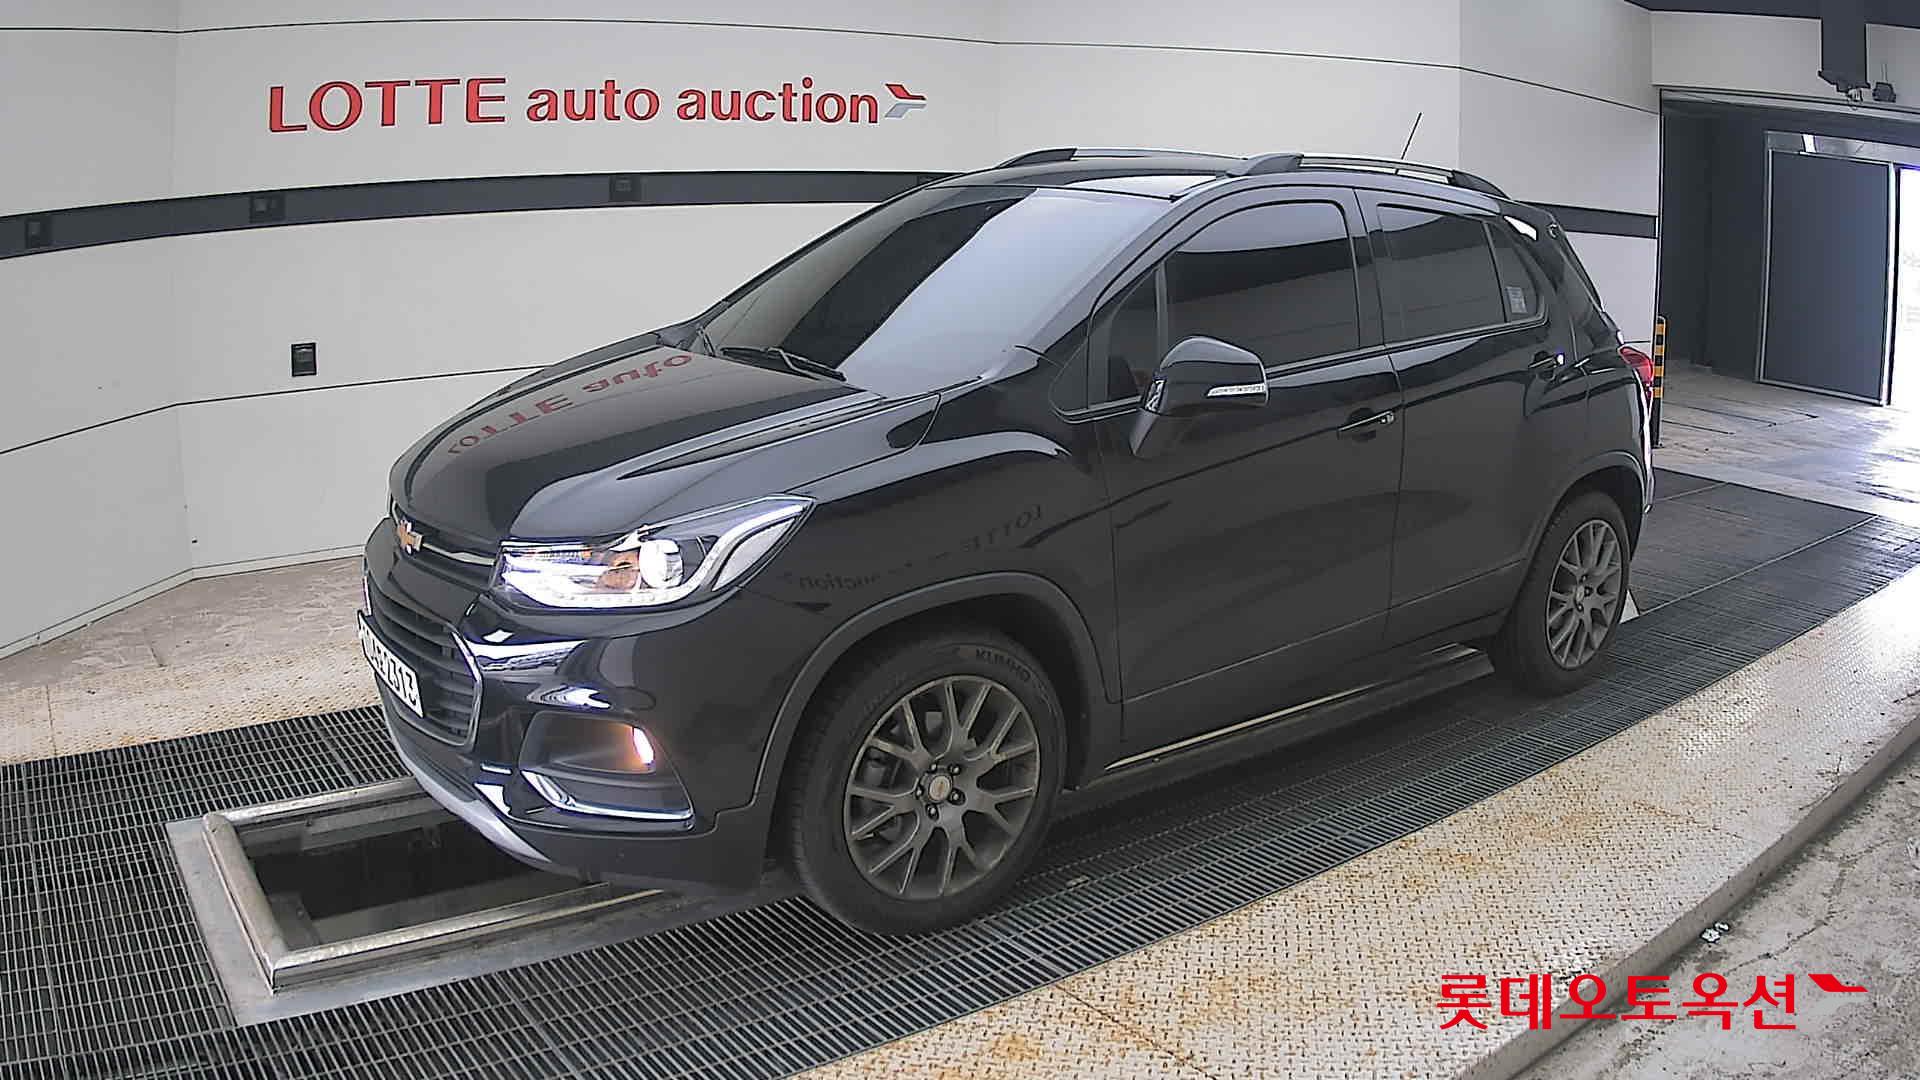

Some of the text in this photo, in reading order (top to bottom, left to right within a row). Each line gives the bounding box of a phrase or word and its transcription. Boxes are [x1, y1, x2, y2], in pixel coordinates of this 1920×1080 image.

[268, 76, 879, 133] LOTTE auto auction
